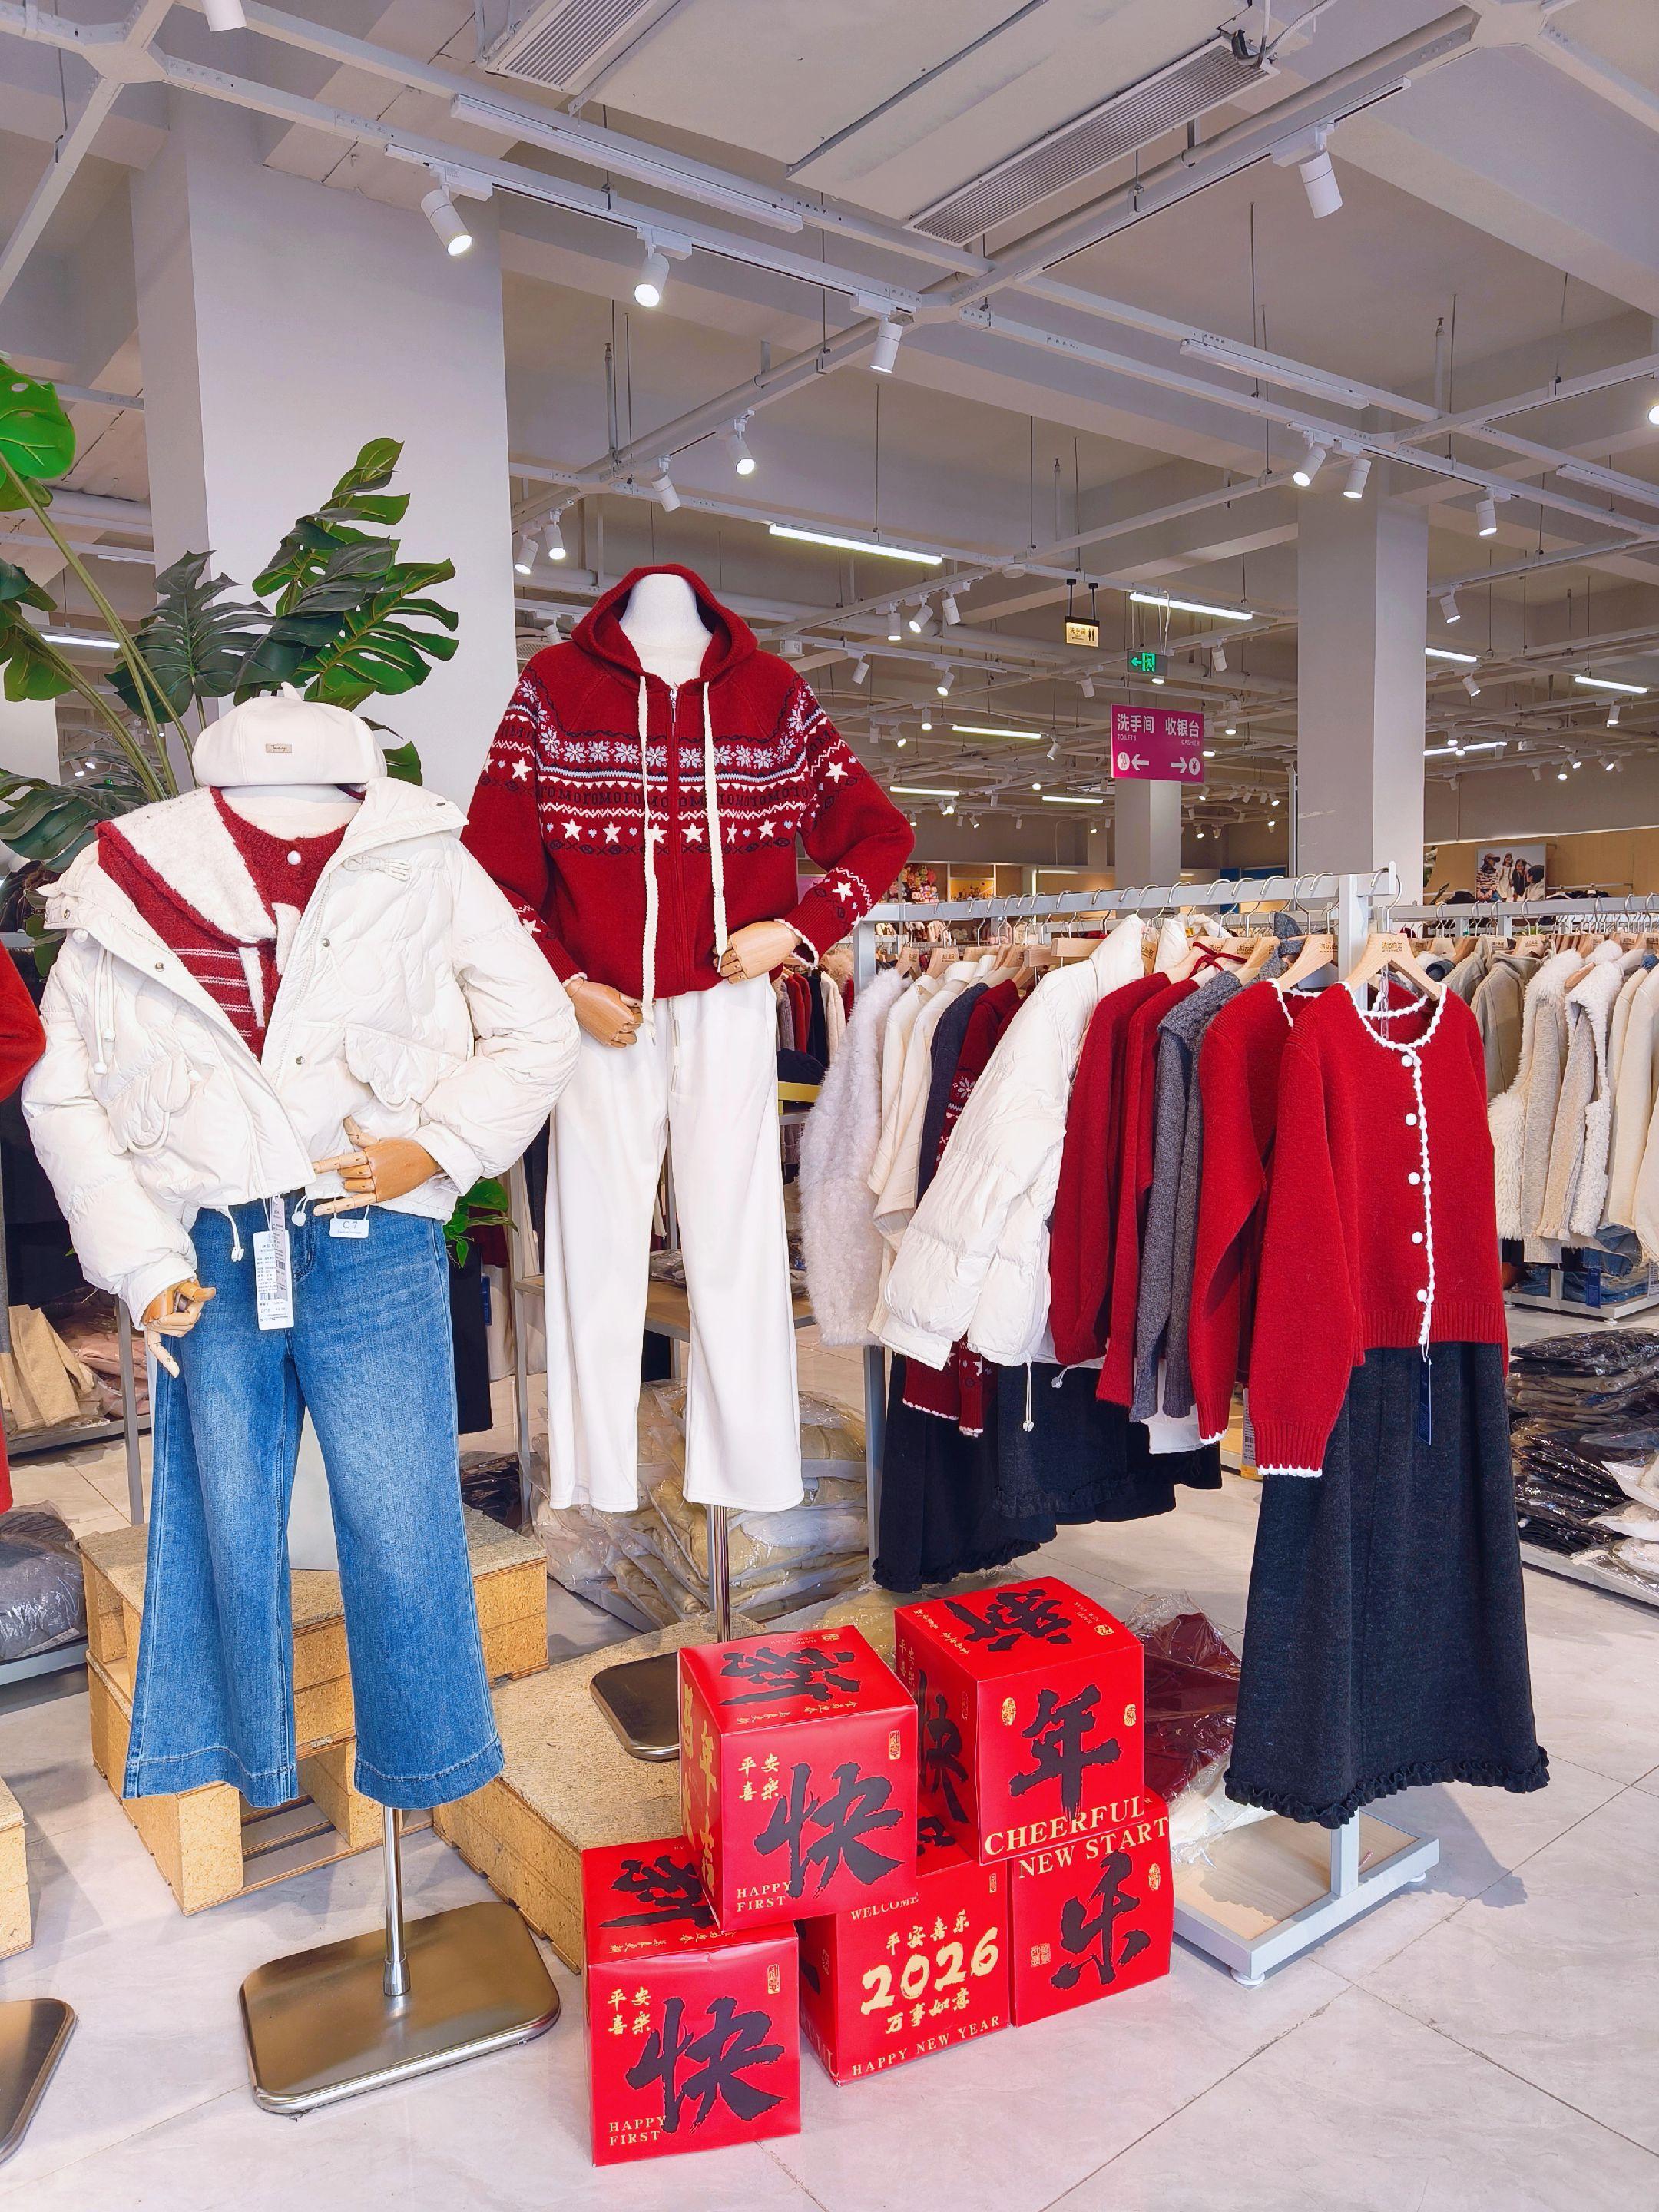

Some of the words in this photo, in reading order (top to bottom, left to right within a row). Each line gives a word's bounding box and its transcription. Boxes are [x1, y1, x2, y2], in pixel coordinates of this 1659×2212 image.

[1117, 713, 1154, 734] 洗手间
[1165, 717, 1200, 738] 收银台
[738, 1753, 780, 1777] 平安
[1008, 1684, 1122, 1824] 年
[754, 1762, 905, 1899] 快
[985, 1796, 1144, 1856] CHEERFUL
[1018, 1845, 1075, 1879] NEW
[1085, 1816, 1168, 1861] START
[737, 1880, 792, 1899] HAPPY
[737, 1896, 785, 1912] FIRST
[1051, 1849, 1151, 1991] 乐
[860, 1926, 998, 2015] 2026
[608, 1986, 651, 2011] 平安
[885, 1987, 970, 2034] 万事如意
[625, 1996, 788, 2134] 快
[852, 2048, 908, 2076] HAPPY
[916, 2032, 949, 2054] NEW
[958, 2015, 999, 2040] YEAR
[609, 2115, 666, 2133] HAPPY
[609, 2131, 661, 2146] FIRST
